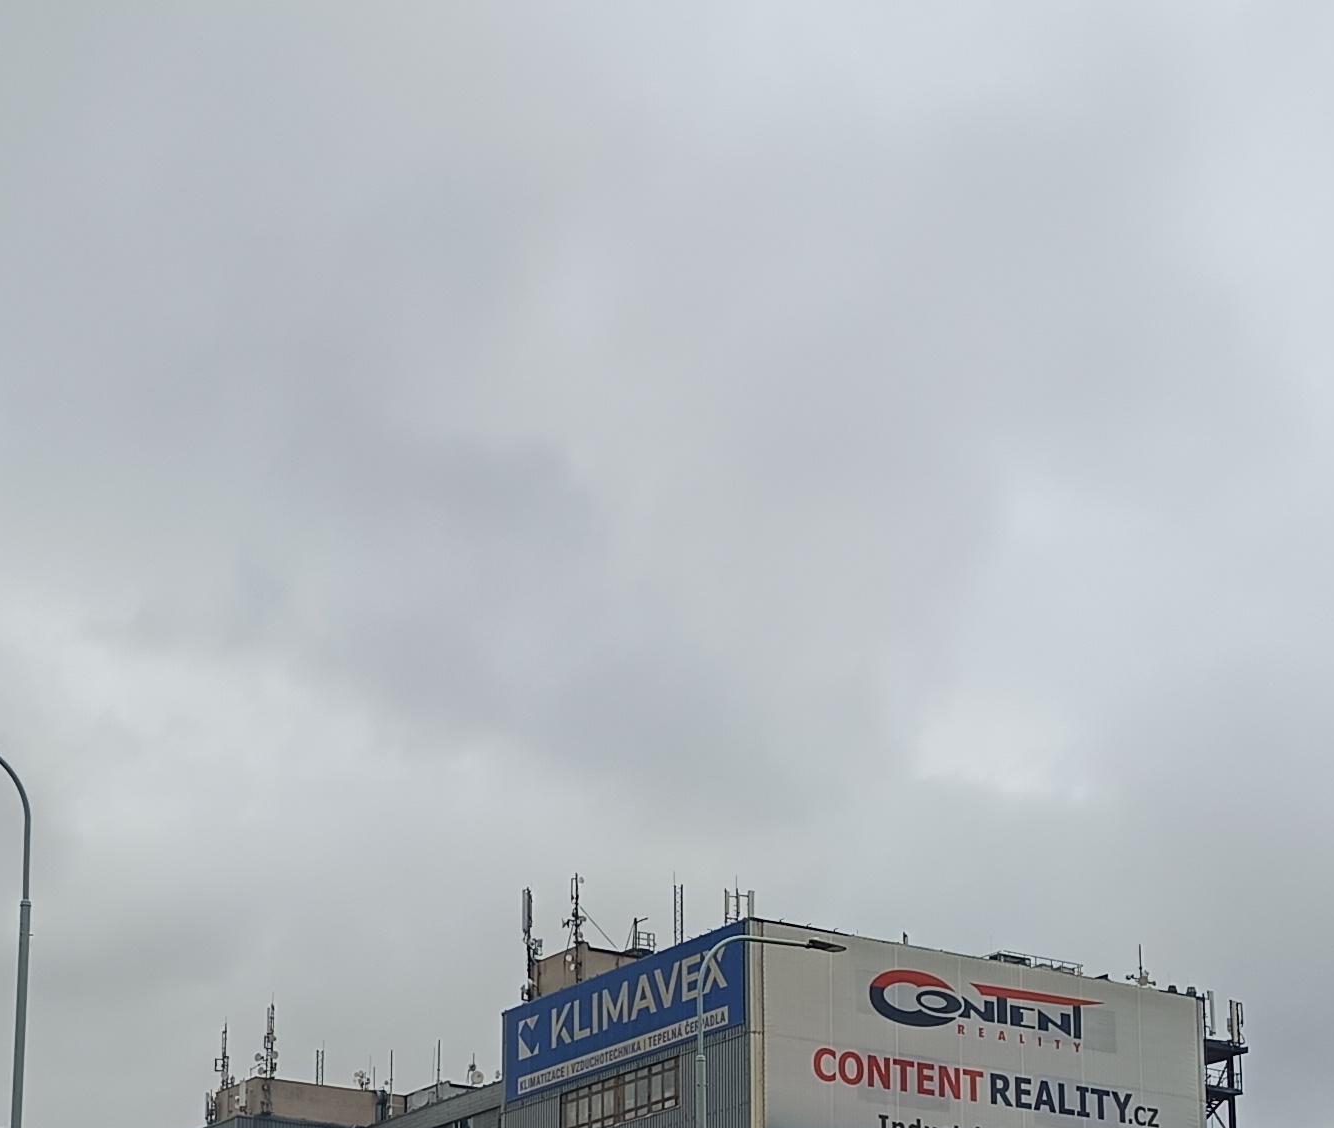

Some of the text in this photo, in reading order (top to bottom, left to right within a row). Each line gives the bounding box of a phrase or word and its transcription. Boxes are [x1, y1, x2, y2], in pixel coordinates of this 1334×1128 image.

[551, 946, 728, 1049] KLIMAVEX
[957, 1024, 1082, 1053] REALITY
[519, 1010, 727, 1092] KLIMATIZACE VZDUCHOTECHNIKA TEPELNÁ ČERADLA
